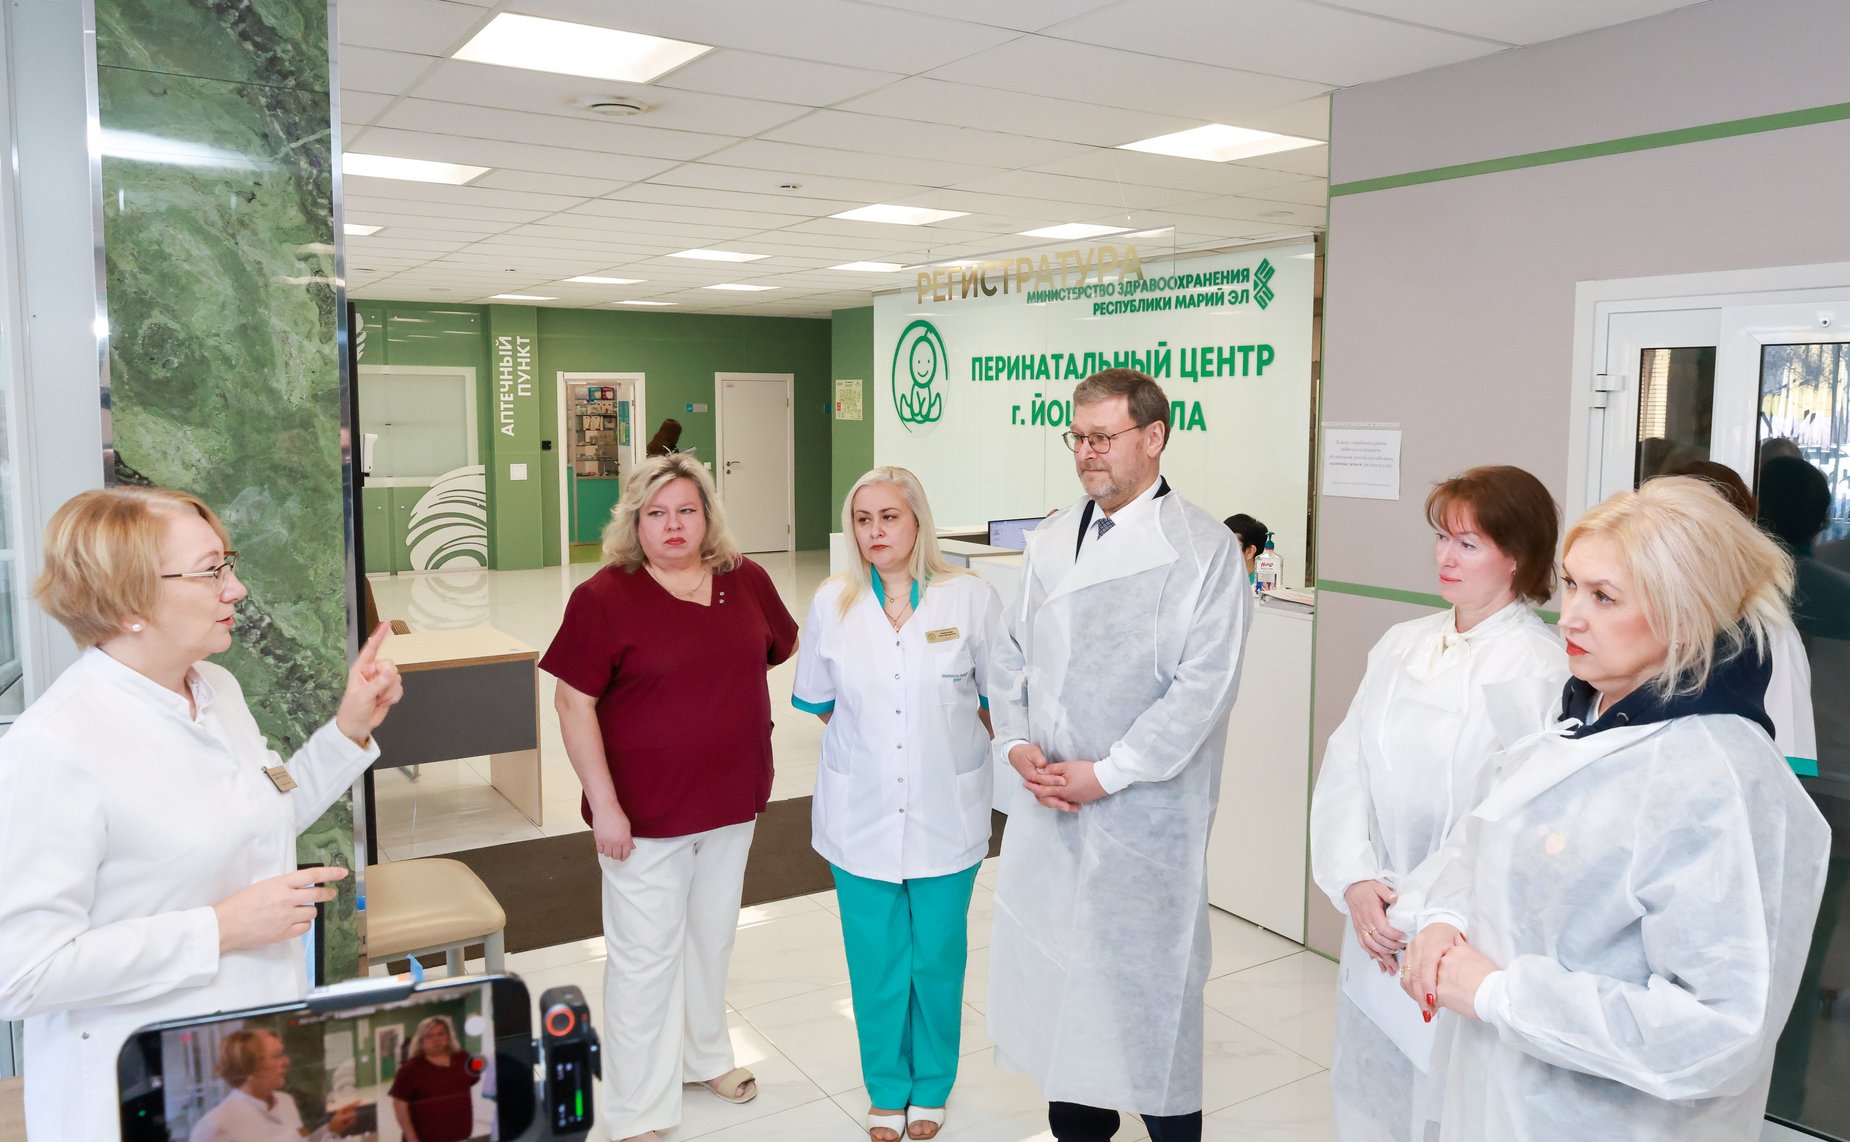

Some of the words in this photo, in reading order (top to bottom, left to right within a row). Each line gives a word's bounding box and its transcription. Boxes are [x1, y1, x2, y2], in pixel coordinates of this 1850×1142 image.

[917, 242, 1145, 304] РЕГИСТРАТУРА
[1027, 284, 1116, 304] МИНИСТЕРСТВО
[1117, 268, 1250, 297] ЗДРАВООХРАНЕНИЯ
[1093, 296, 1172, 316] РЕСПУБЛИКИ
[1175, 287, 1225, 310] МАРИЙ
[1228, 289, 1250, 305] ЭЛ
[517, 336, 531, 397] ПУНКТ
[971, 341, 1171, 382] ПЕРИНАТАЛЬНЫЙ
[1180, 344, 1275, 383] ЦЕНТР
[495, 336, 514, 437] АПТЕЧНЫЙ
[1012, 405, 1026, 425] г.
